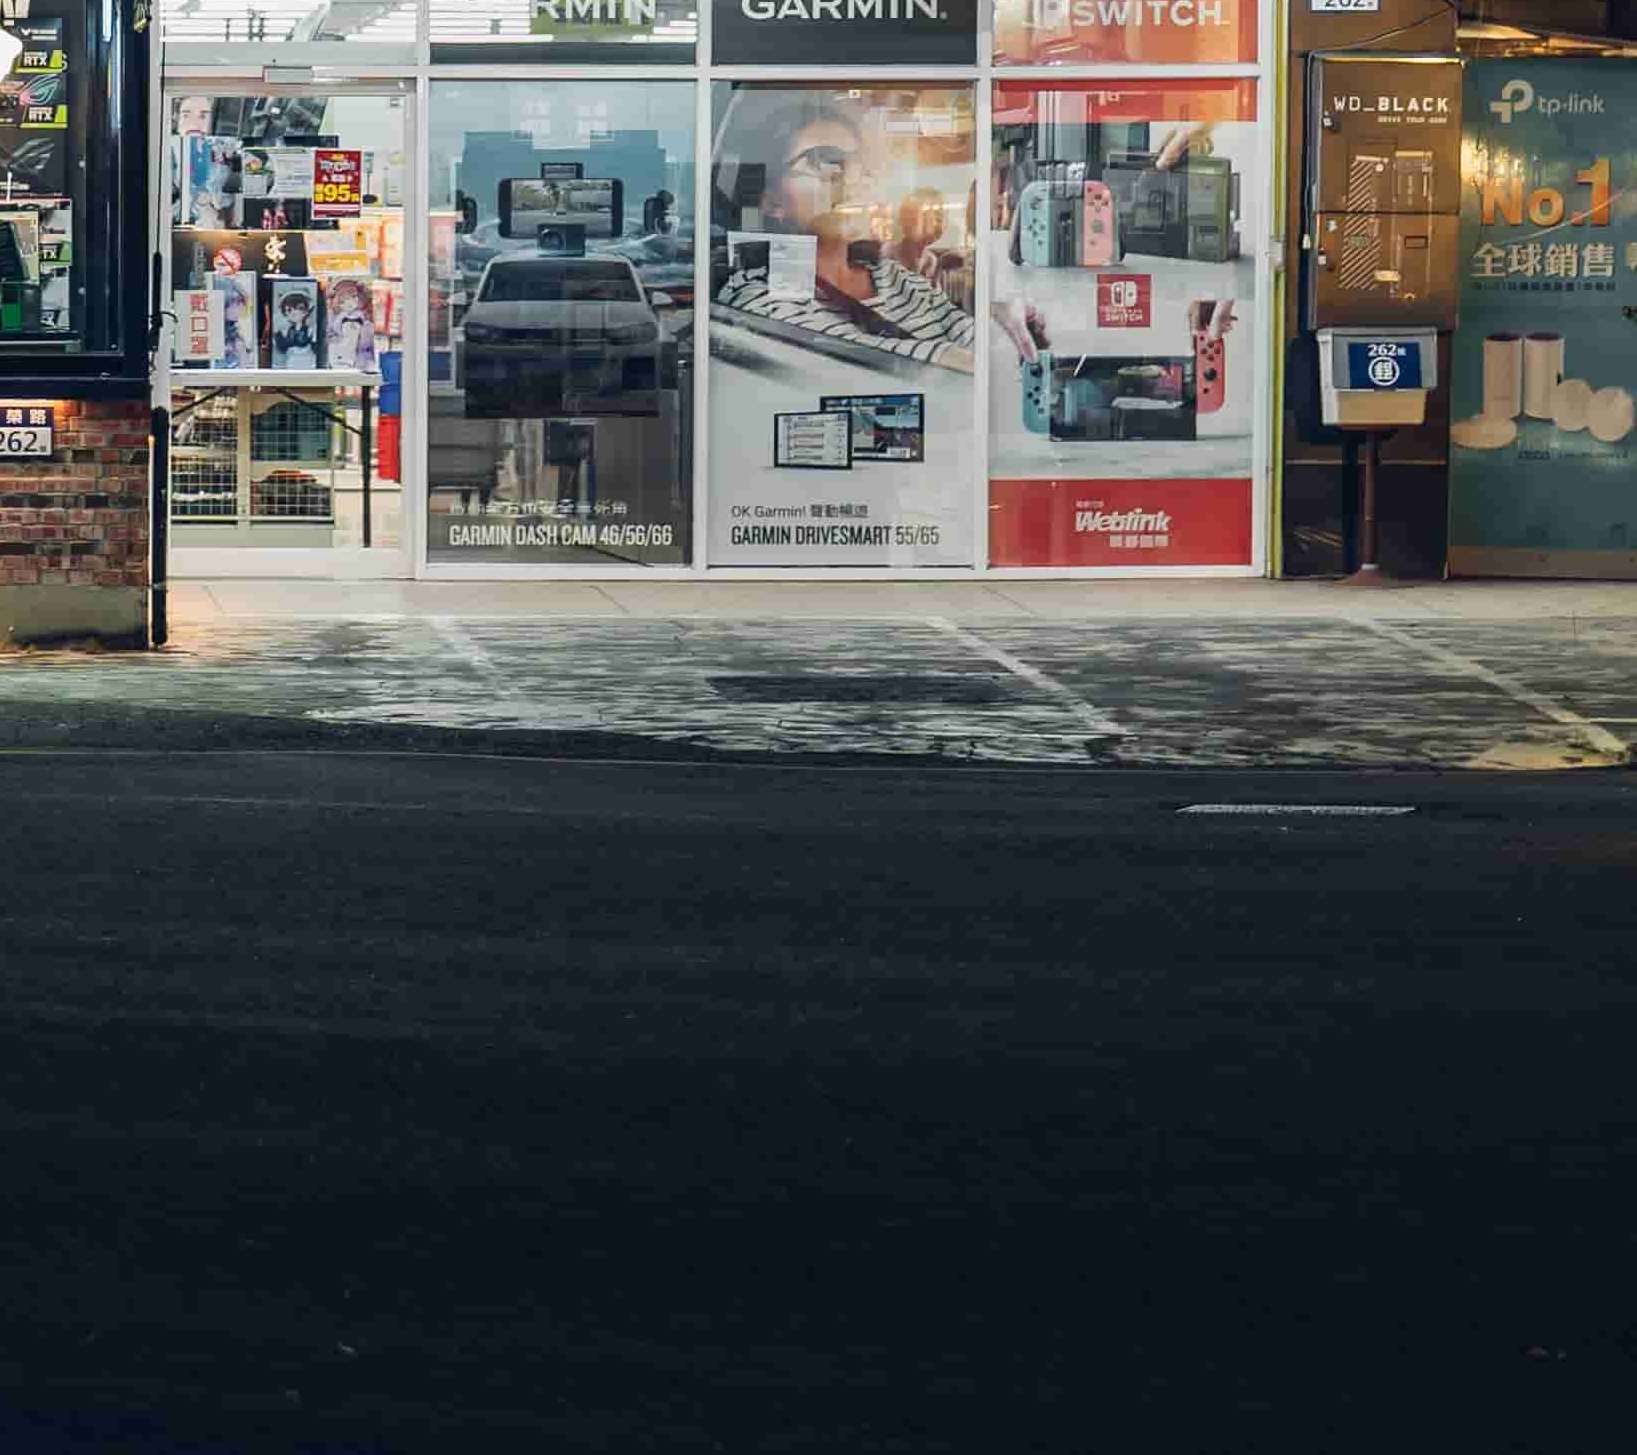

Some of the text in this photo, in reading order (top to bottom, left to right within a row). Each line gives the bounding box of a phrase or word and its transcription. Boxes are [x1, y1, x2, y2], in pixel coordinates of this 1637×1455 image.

[1072, 0, 1223, 27] SWITCH
[1333, 95, 1450, 113] WD_BLACK
[1538, 93, 1605, 117] tp-link
[1479, 156, 1612, 228] No.1
[1472, 242, 1616, 279] 全球銷售
[731, 505, 751, 518] OK
[449, 524, 673, 546] GARMIN DASH CAM 46/56/66
[731, 525, 940, 546] GARMIN DRIVESMART 55/65
